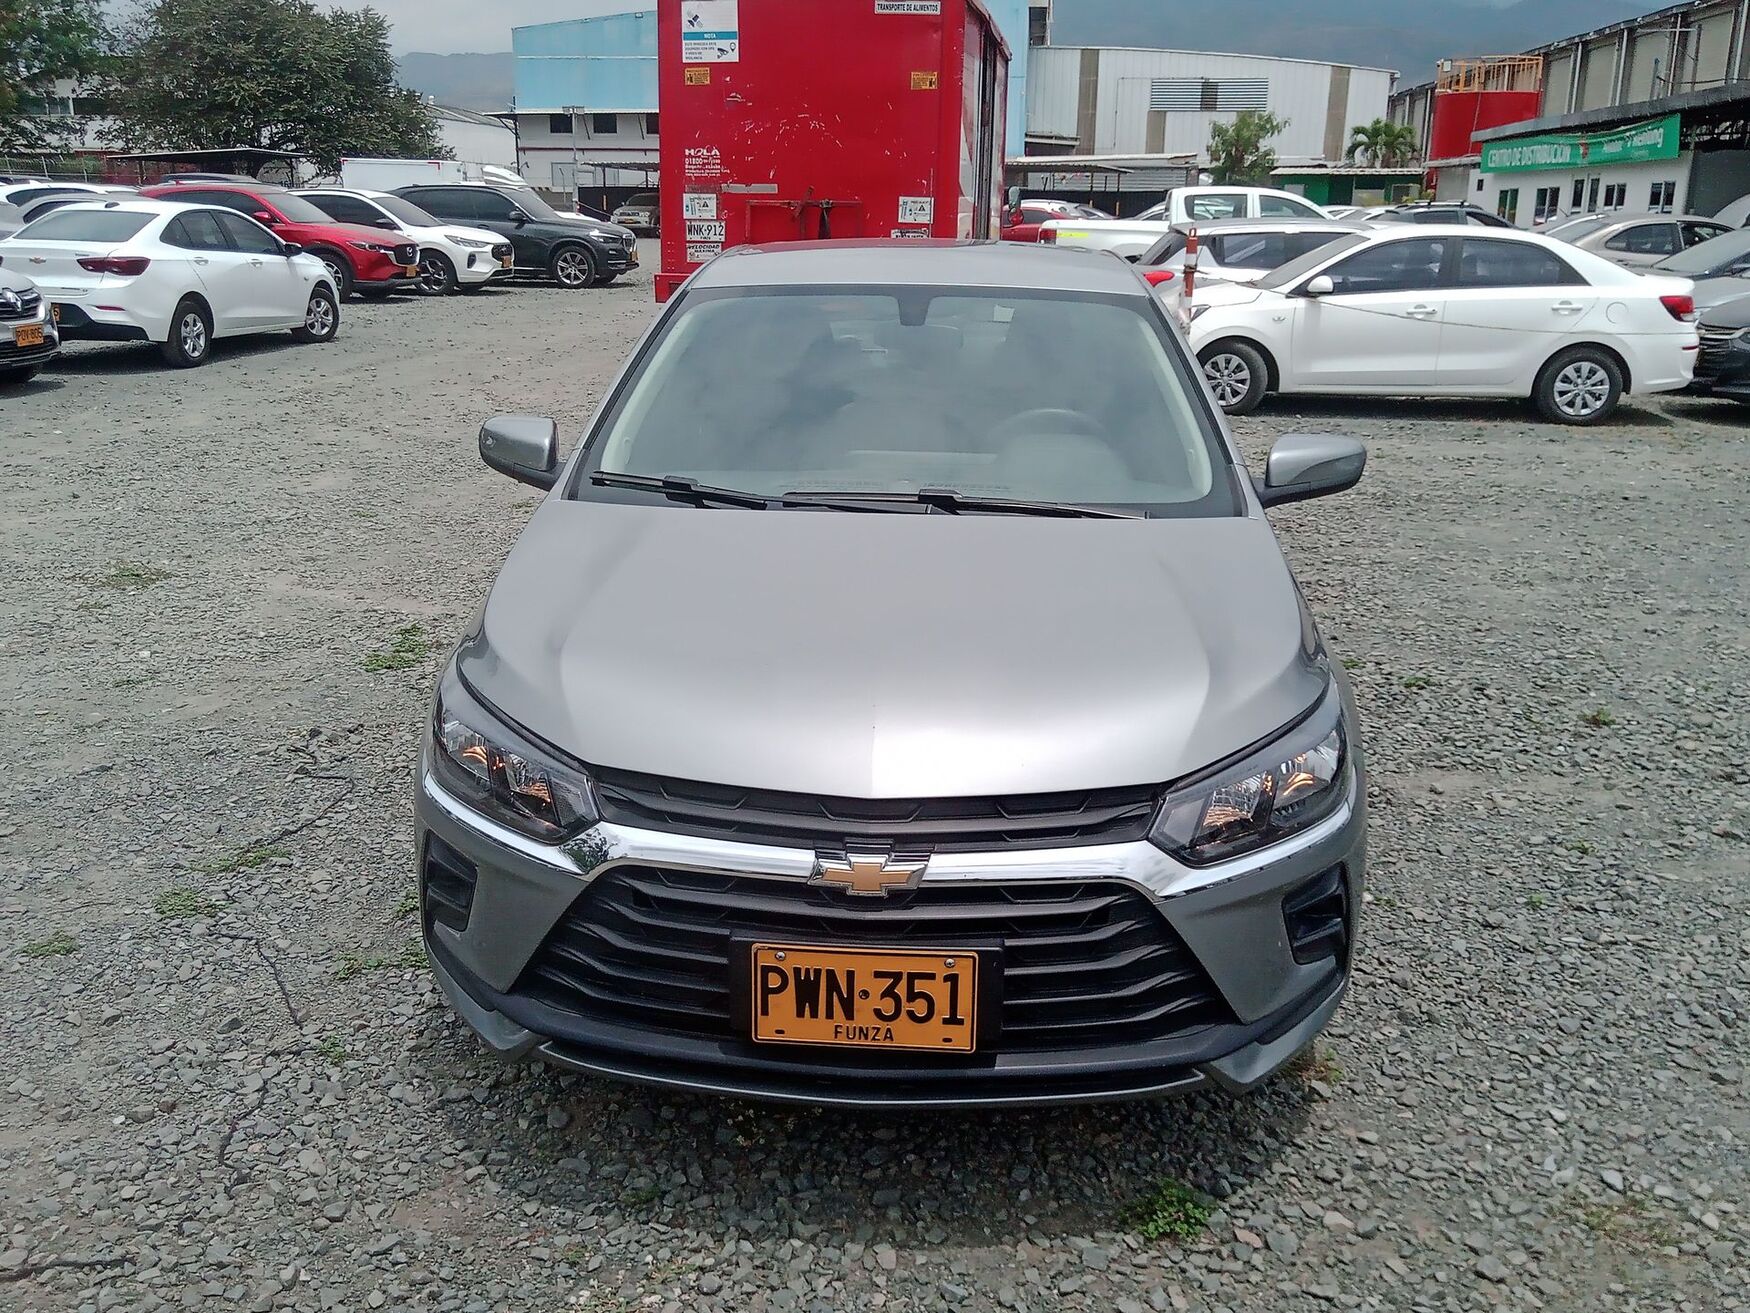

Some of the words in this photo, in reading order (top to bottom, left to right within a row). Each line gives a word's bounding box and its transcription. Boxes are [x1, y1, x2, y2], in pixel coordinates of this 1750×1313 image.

[877, 3, 905, 11] TRANSPORTE
[913, 4, 938, 12] ALIMENTOS
[834, 1024, 894, 1042] FUNZA
